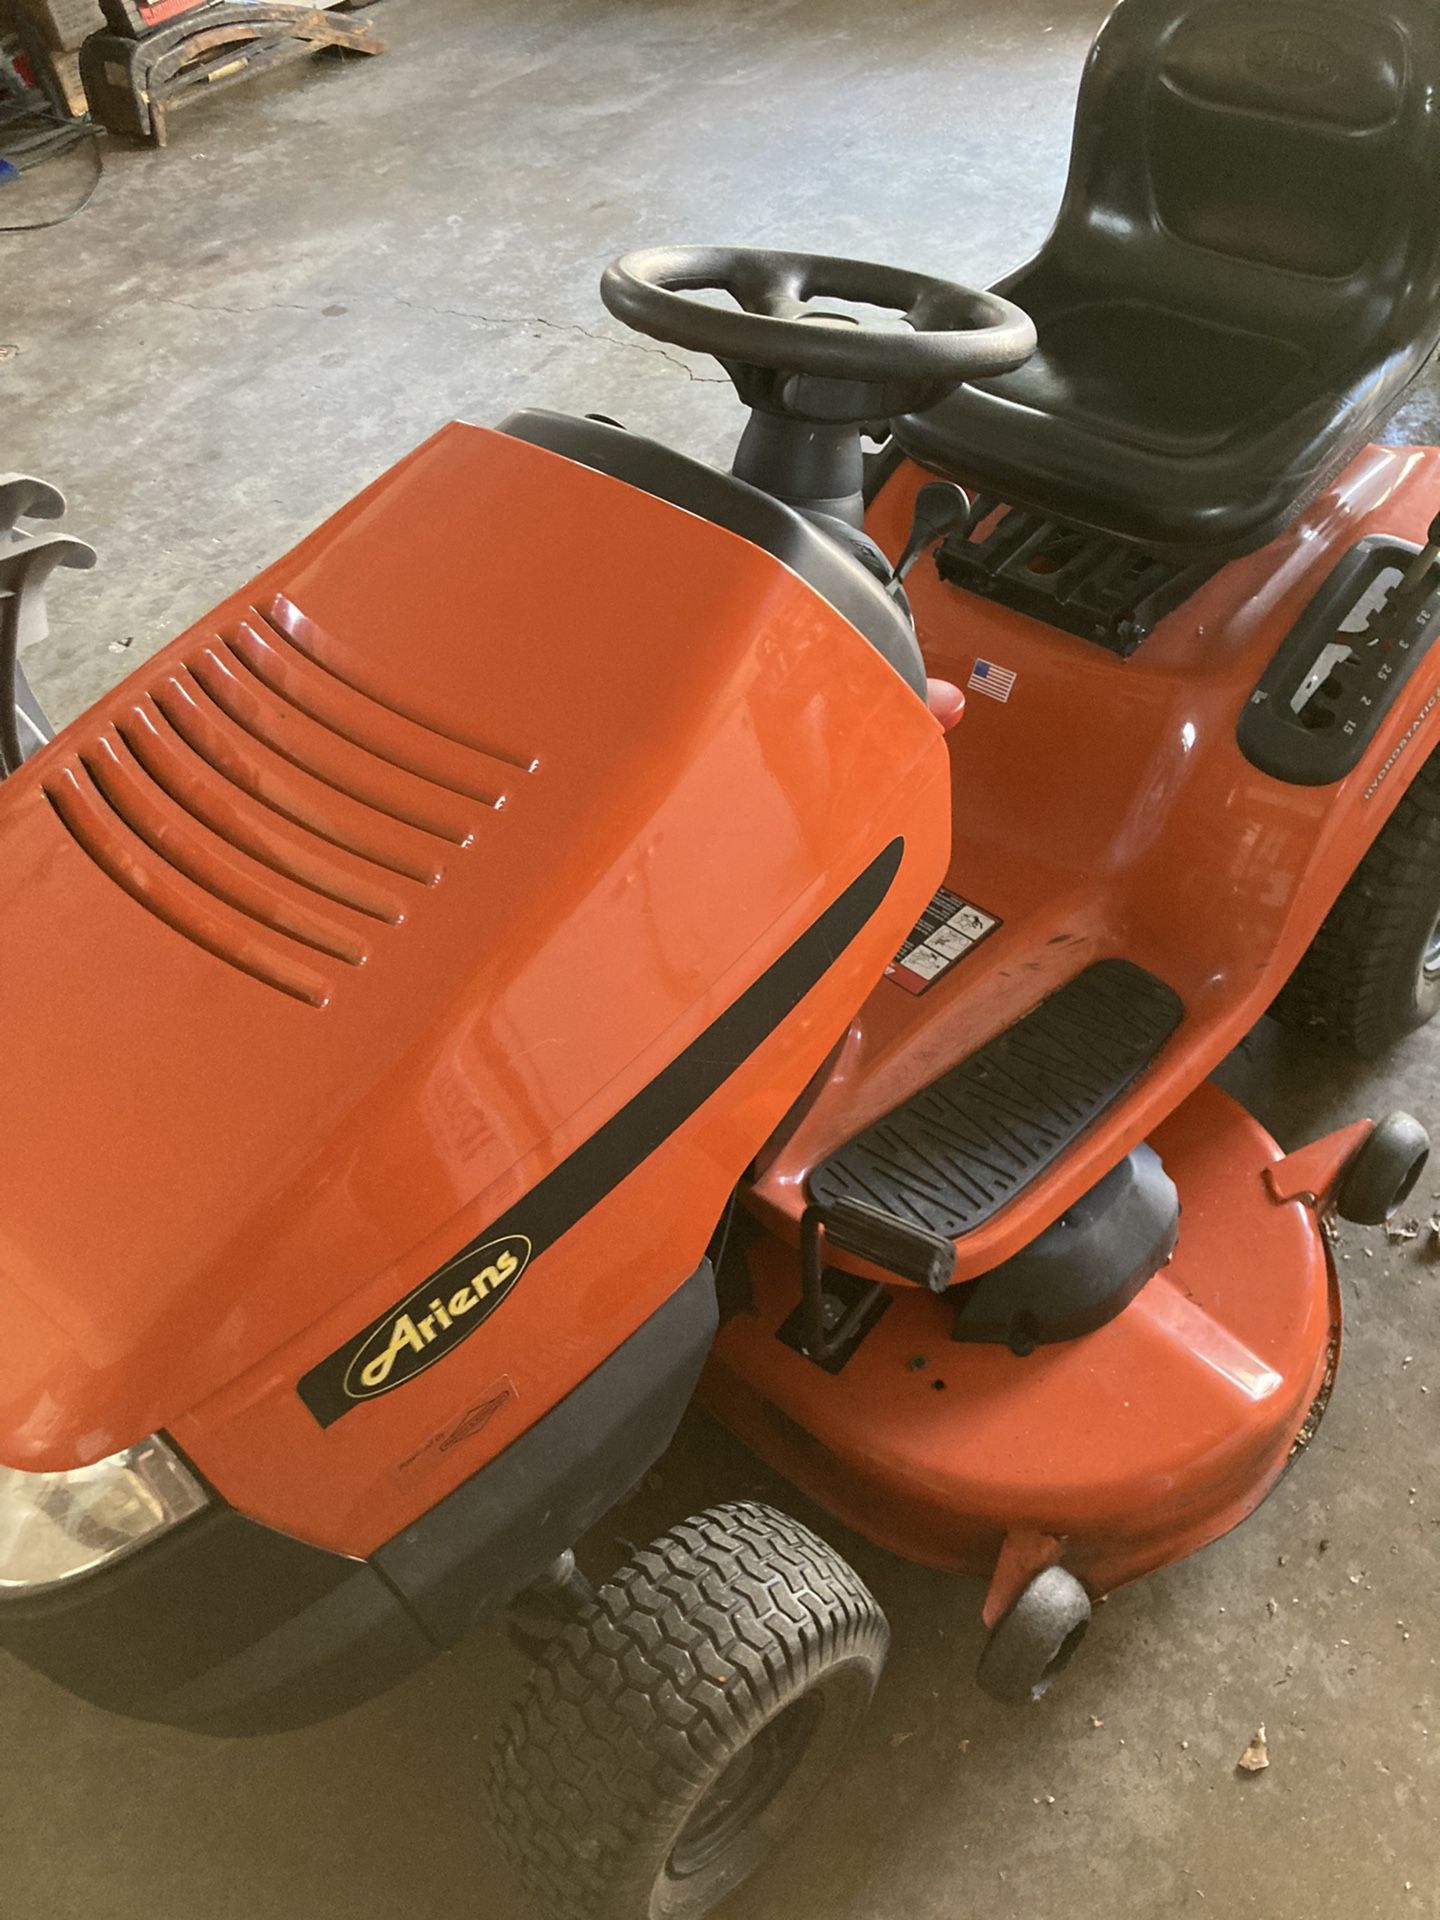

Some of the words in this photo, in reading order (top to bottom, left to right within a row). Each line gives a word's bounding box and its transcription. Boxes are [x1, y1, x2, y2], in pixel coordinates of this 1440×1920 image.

[1360, 695, 1372, 706] 2
[1363, 695, 1437, 800] HYDROSTATIC
[360, 1250, 519, 1387] Ariens
